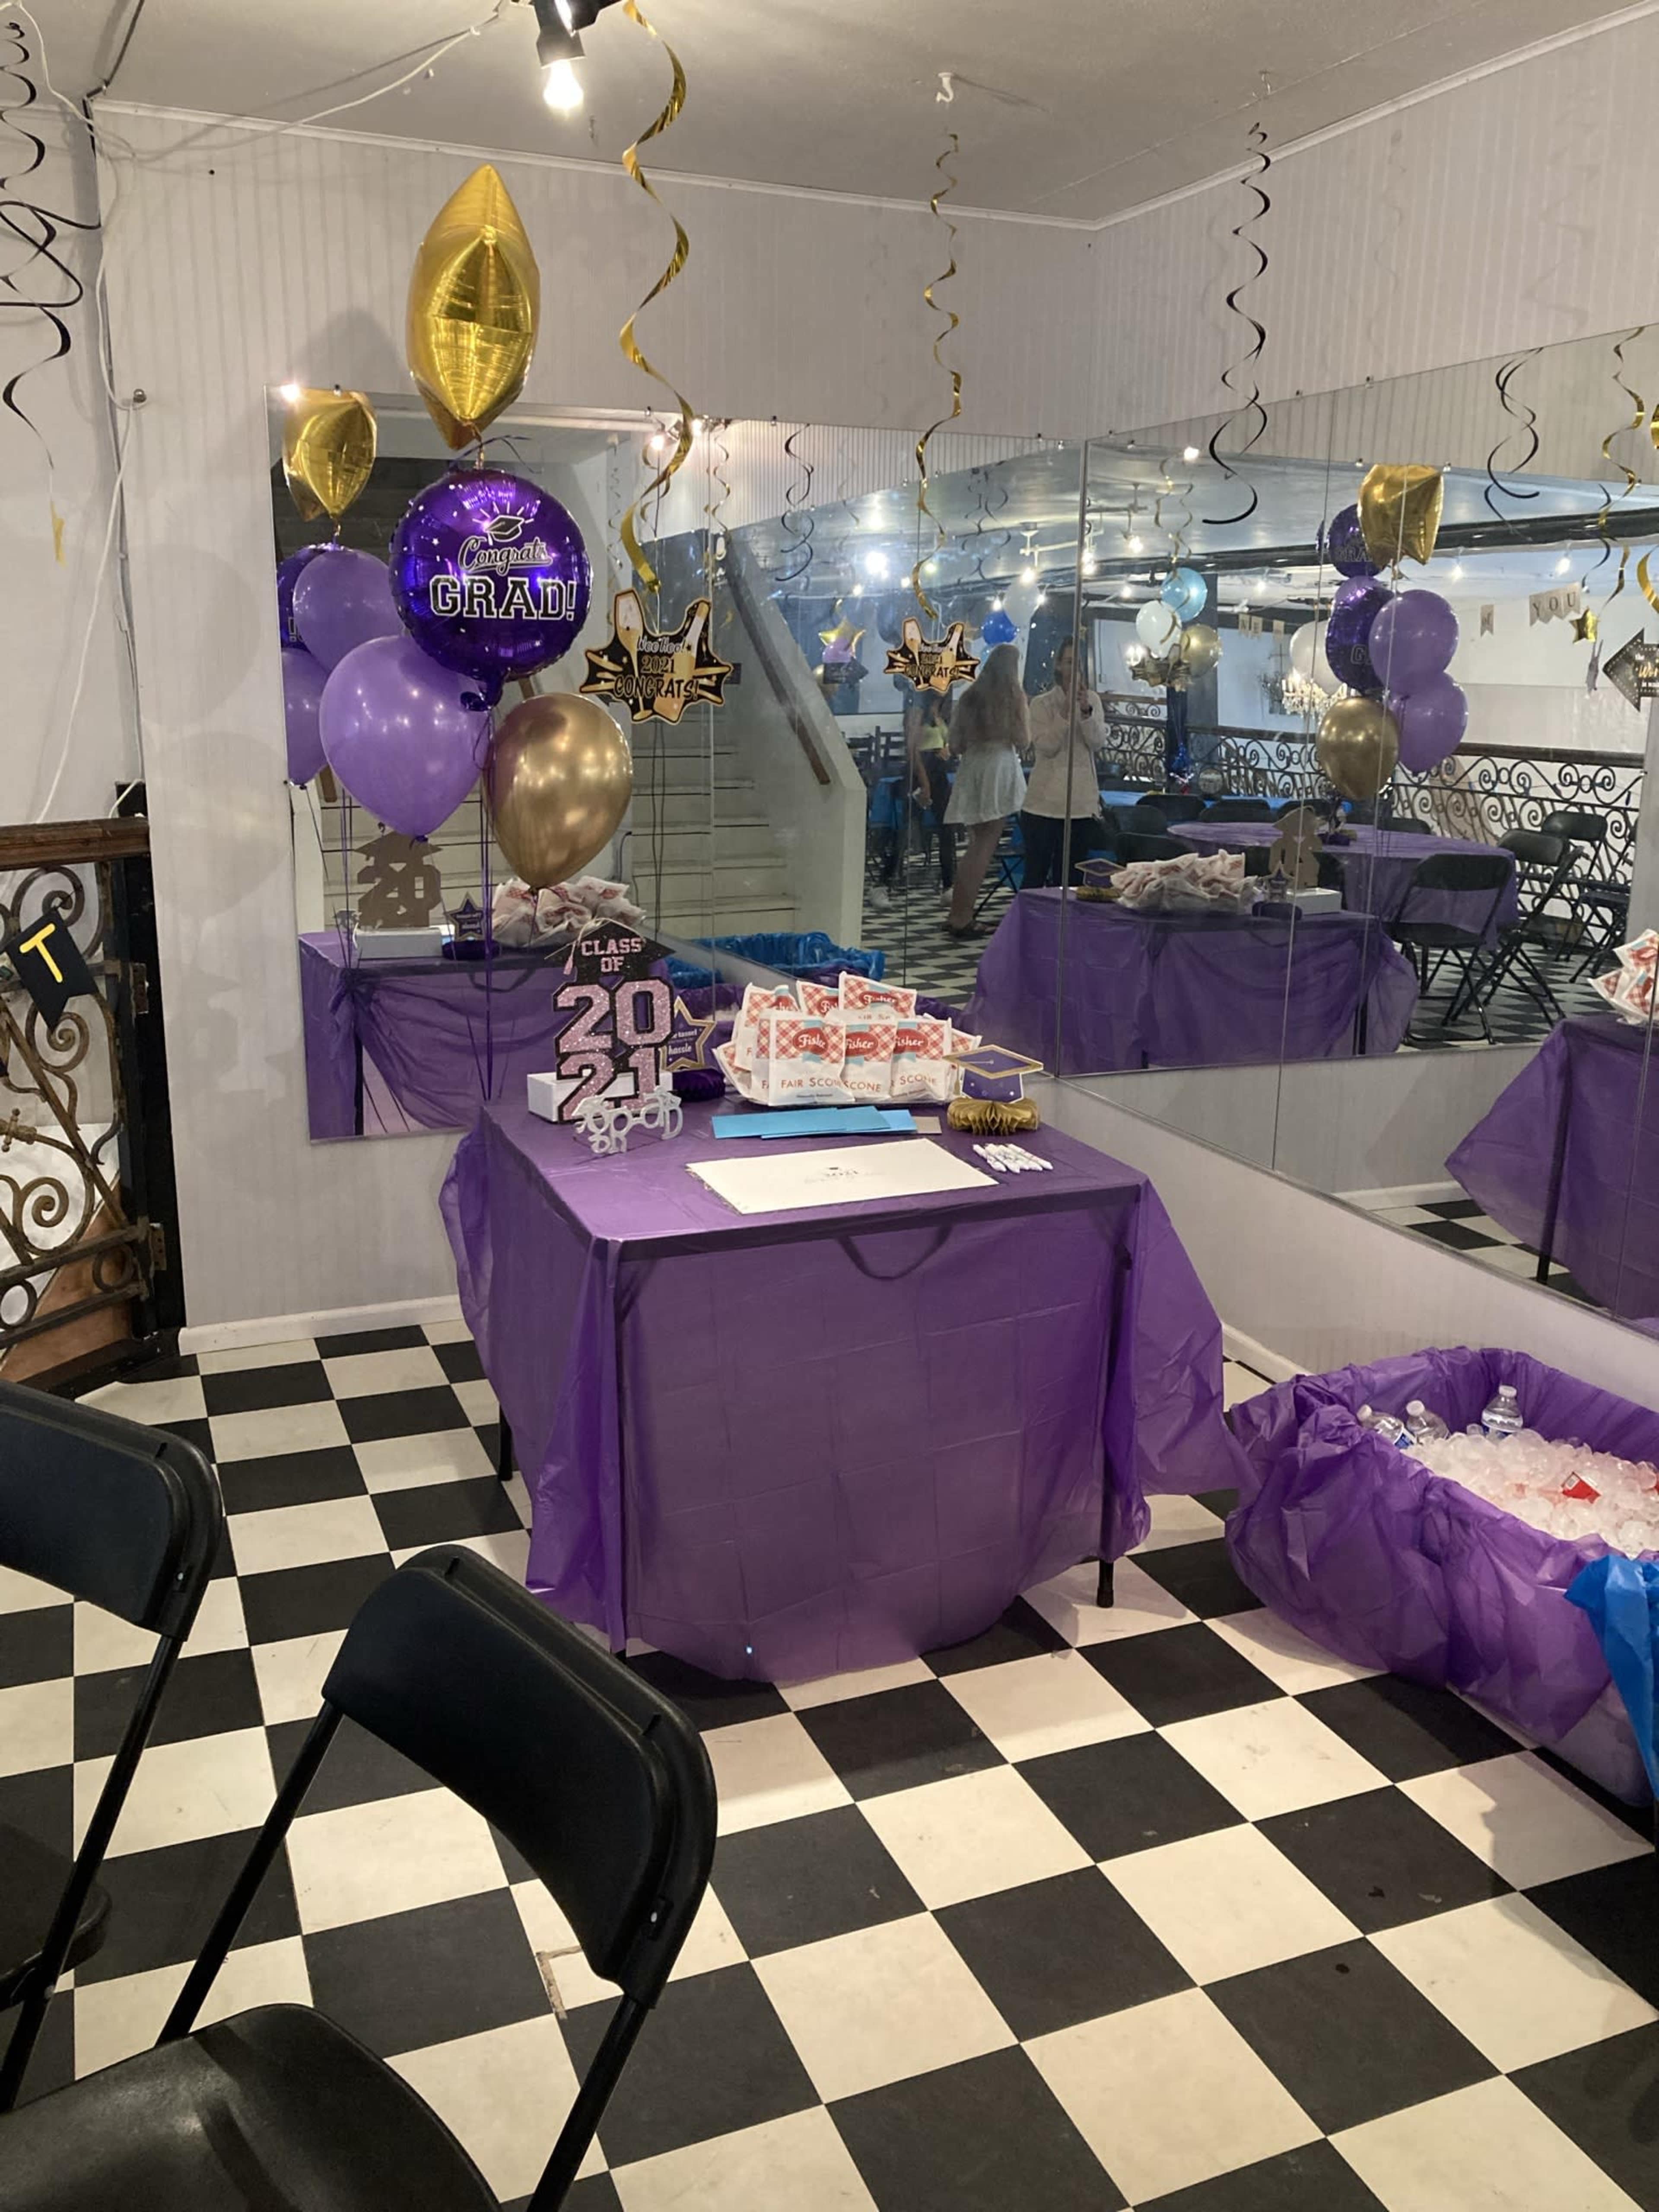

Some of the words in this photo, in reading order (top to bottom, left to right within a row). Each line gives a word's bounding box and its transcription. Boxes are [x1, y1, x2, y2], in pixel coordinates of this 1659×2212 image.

[458, 536, 553, 576] Congrats
[429, 574, 577, 621] GRAD!
[1532, 591, 1576, 618] YOU
[641, 655, 675, 674] 2021
[613, 675, 699, 700] CONGRATS!
[19, 923, 63, 983] T
[581, 938, 642, 956] CLASS
[601, 957, 625, 973] OF
[555, 978, 673, 1054] 20
[558, 1048, 659, 1122] 21
[781, 1079, 803, 1089] FAIR
